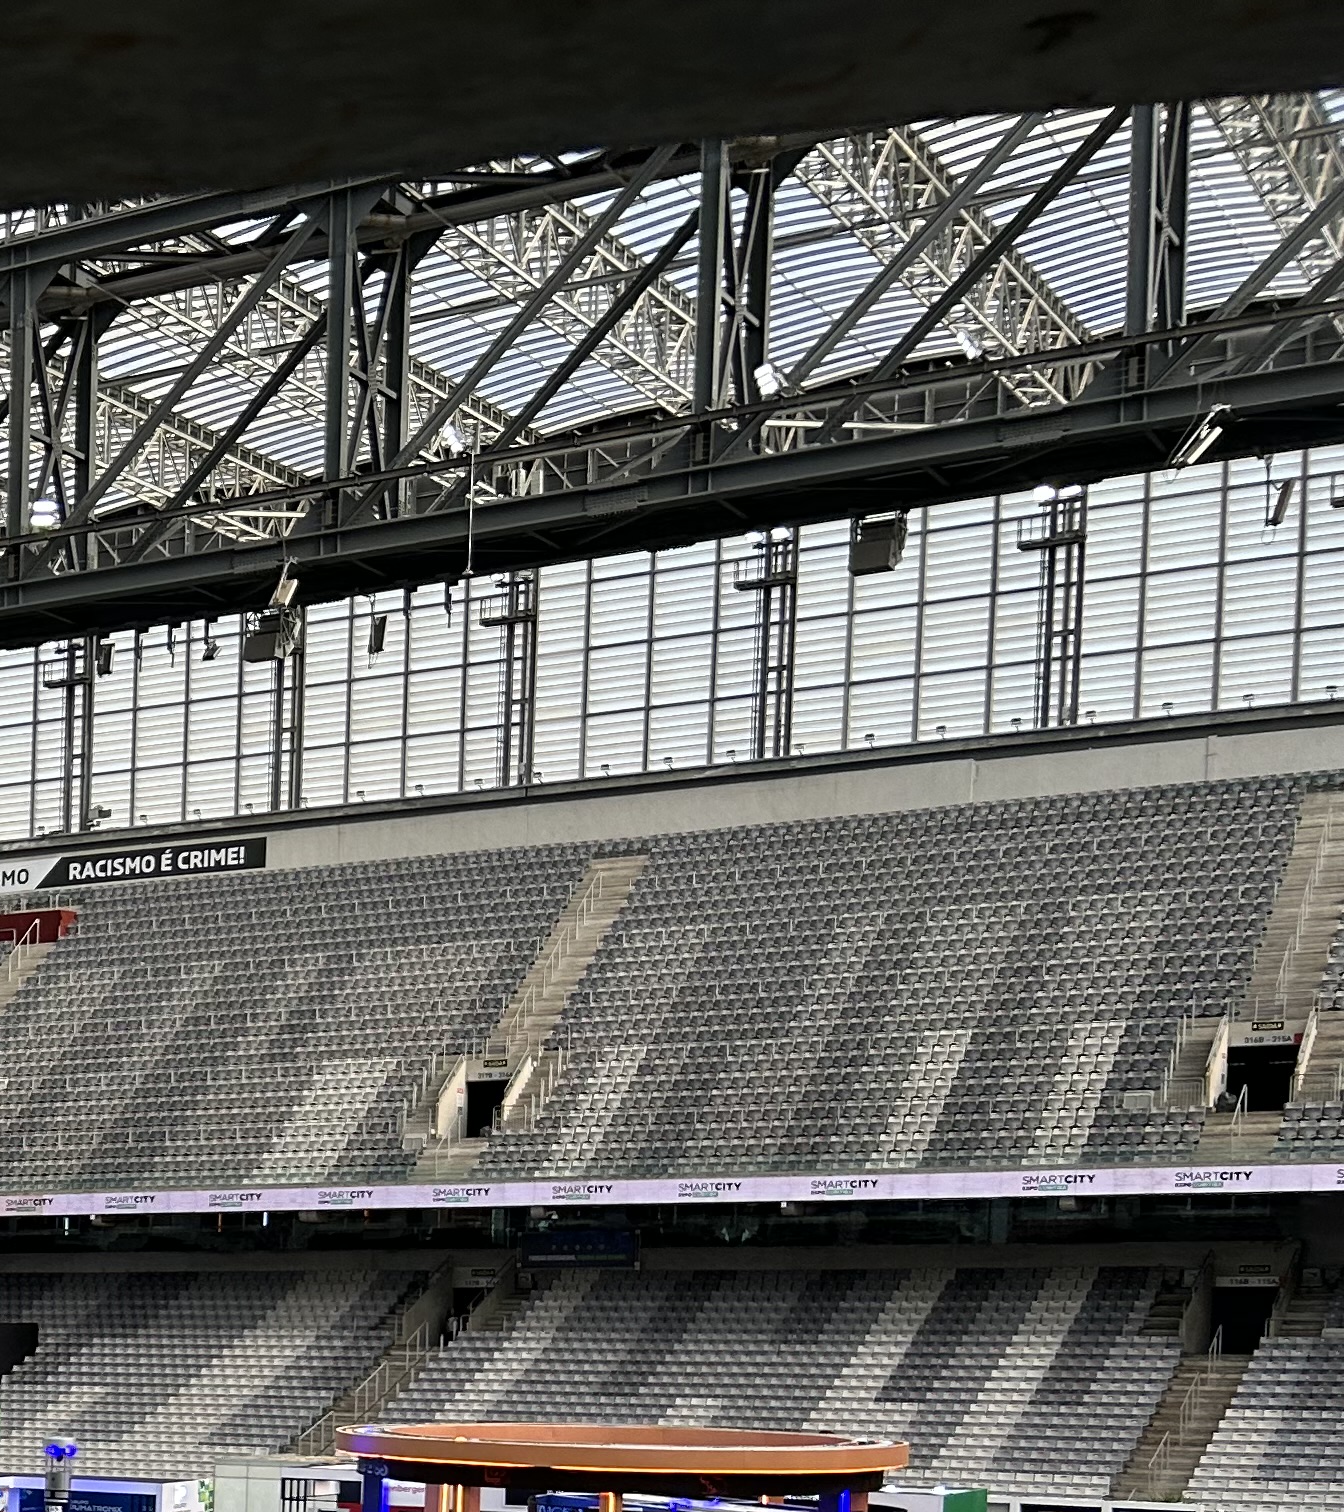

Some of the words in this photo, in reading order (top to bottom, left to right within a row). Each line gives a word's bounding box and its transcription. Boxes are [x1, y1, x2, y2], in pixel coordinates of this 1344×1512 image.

[68, 854, 154, 881] RACISMO
[160, 848, 172, 872] É
[177, 845, 246, 869] CRIME!
[1022, 1174, 1096, 1186] SMARTCITY
[1174, 1171, 1253, 1183] SMARTCITY
[552, 1184, 613, 1195] SMARTCITY
[678, 1182, 742, 1193] SMARTCITY
[810, 1179, 879, 1190] SMARTCITY
[209, 1192, 262, 1202] SMARTCITY
[318, 1190, 373, 1200] SMARTCITY
[432, 1188, 490, 1198] SMARTCITY
[5, 1198, 54, 1208] SMARTCITY
[105, 1196, 155, 1205] SMARTCITY
